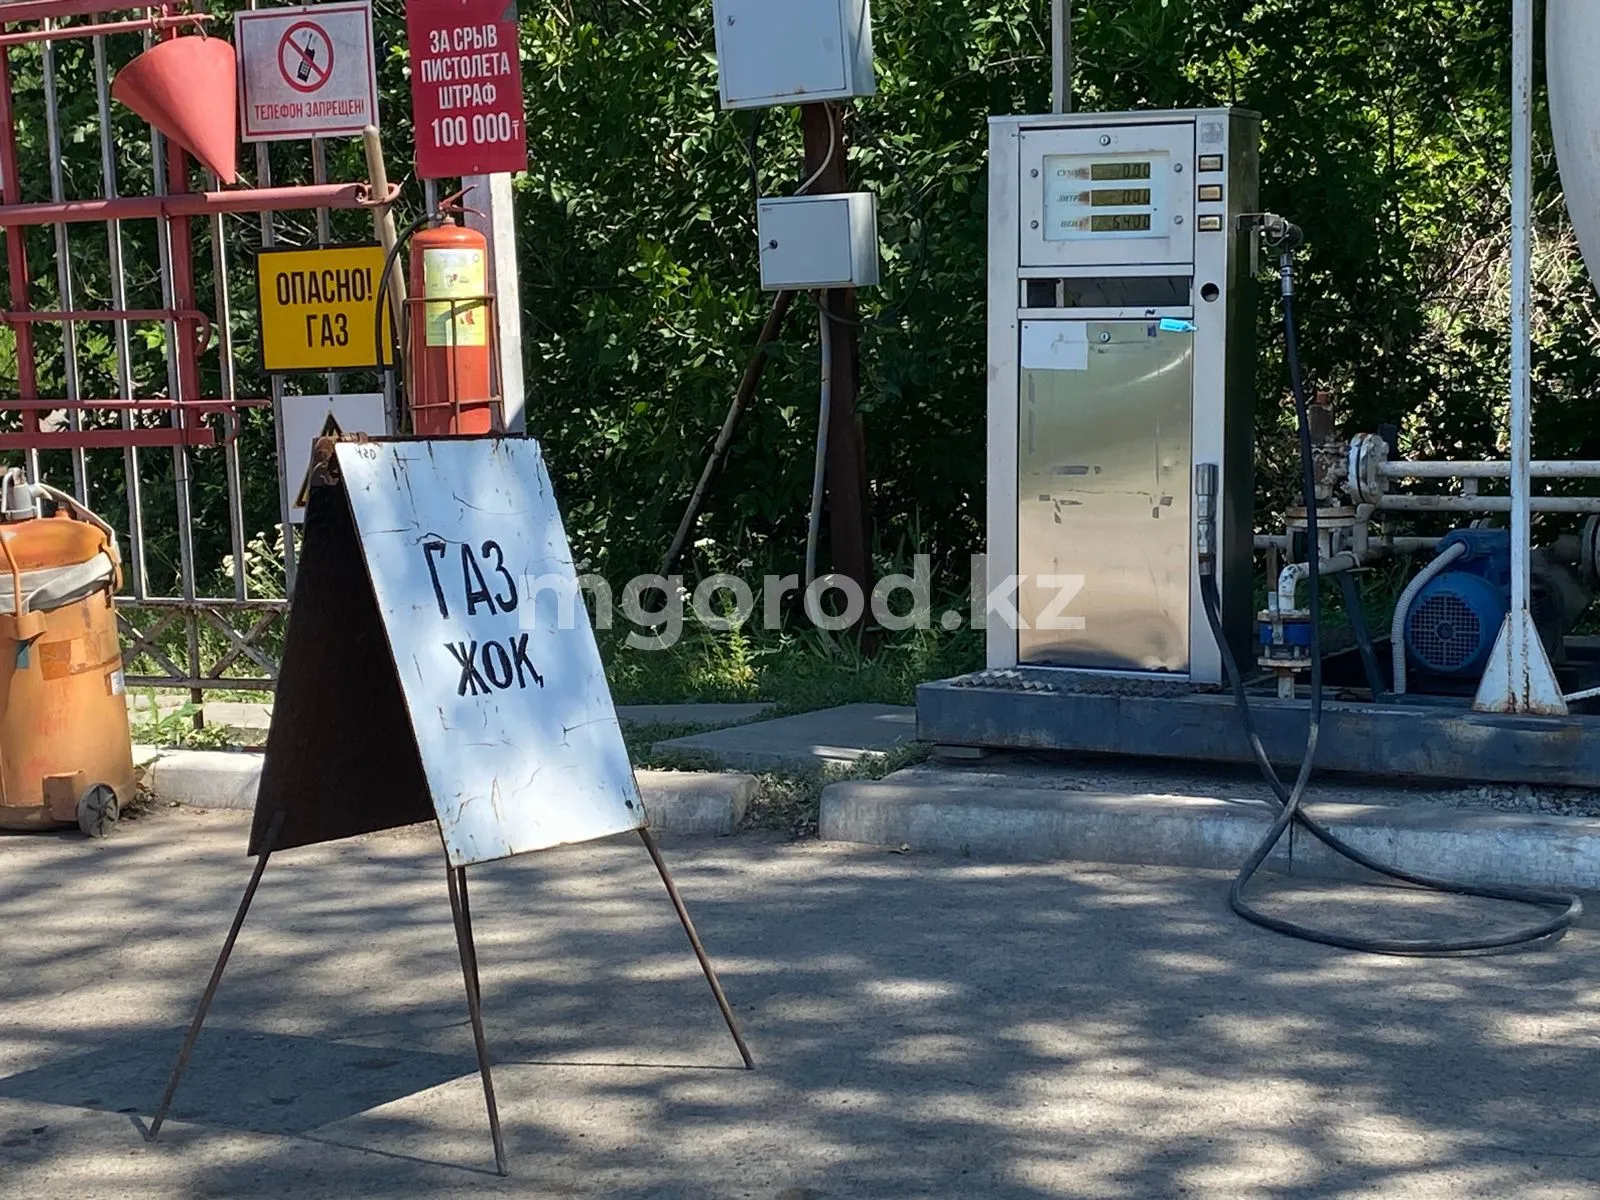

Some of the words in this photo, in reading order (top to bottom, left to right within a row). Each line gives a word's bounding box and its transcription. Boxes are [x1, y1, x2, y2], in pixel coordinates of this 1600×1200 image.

[429, 30, 451, 54] ЗА
[453, 24, 498, 51] СРЫВ
[420, 51, 511, 83] ПИСТОЛЕТА
[254, 101, 303, 120] ТЕЛЕФОН
[438, 82, 497, 110] ШТРАФ
[431, 115, 468, 148] 100
[275, 267, 373, 306] ОПАСНО!
[305, 312, 349, 348] ГАЗ
[422, 539, 518, 620] ГАЗ
[444, 632, 544, 697] ЖОҚ
